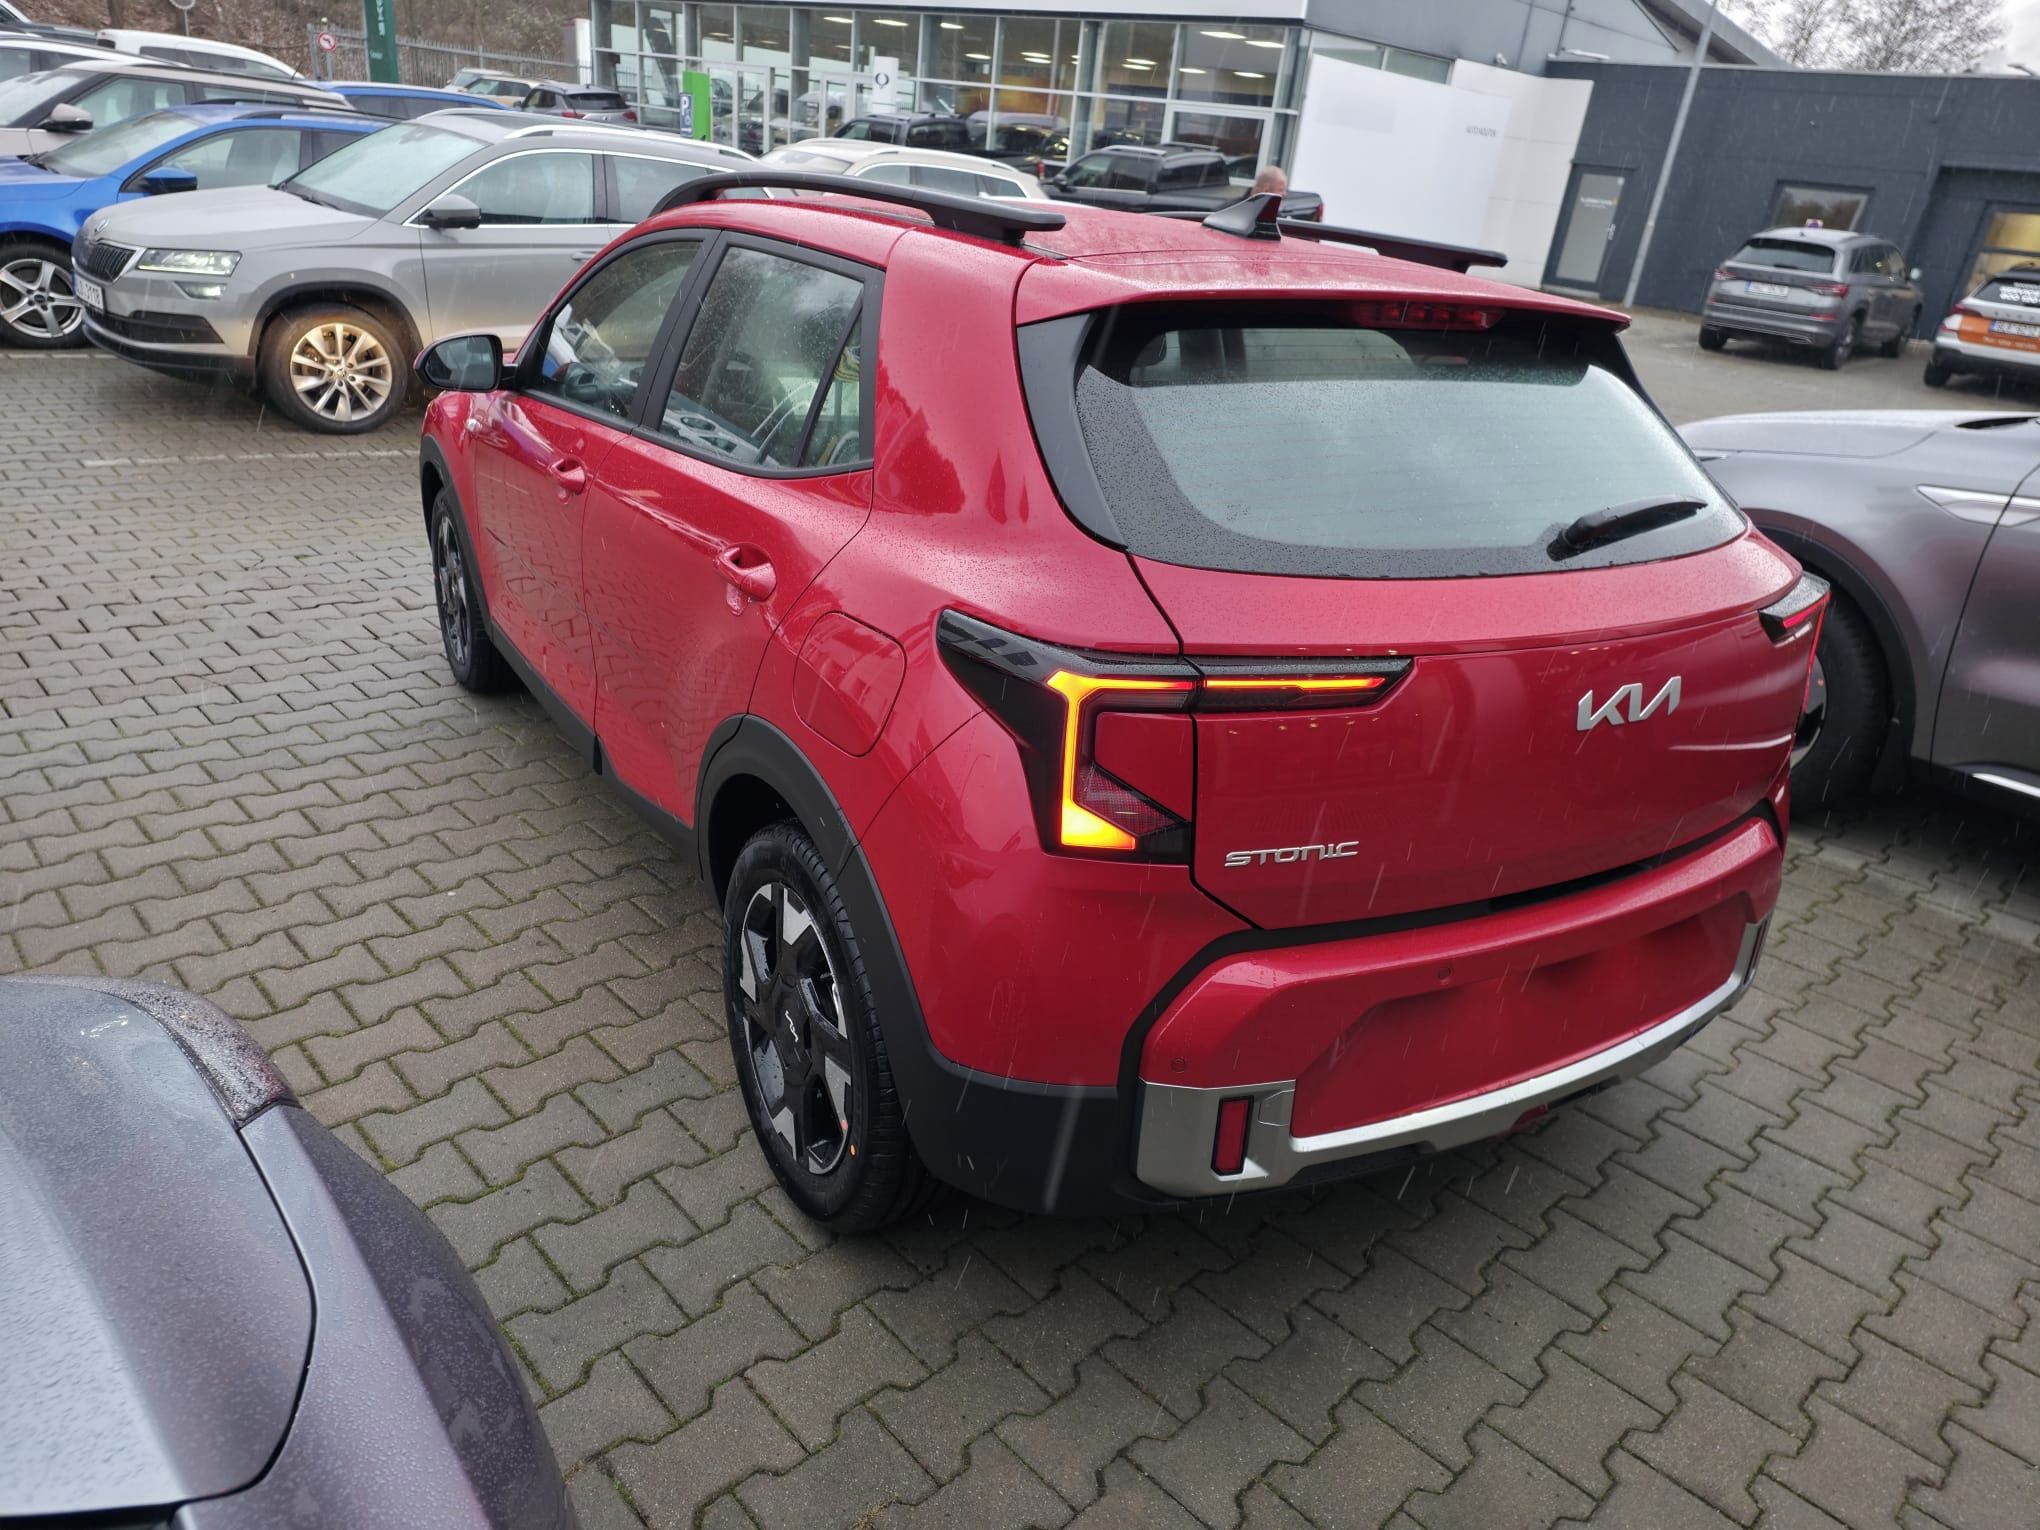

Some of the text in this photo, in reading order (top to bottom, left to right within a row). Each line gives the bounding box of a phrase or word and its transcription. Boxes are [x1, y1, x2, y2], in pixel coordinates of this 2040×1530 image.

[681, 96, 690, 116] P
[1576, 675, 1682, 731] KIA
[1224, 841, 1360, 867] STONIC
